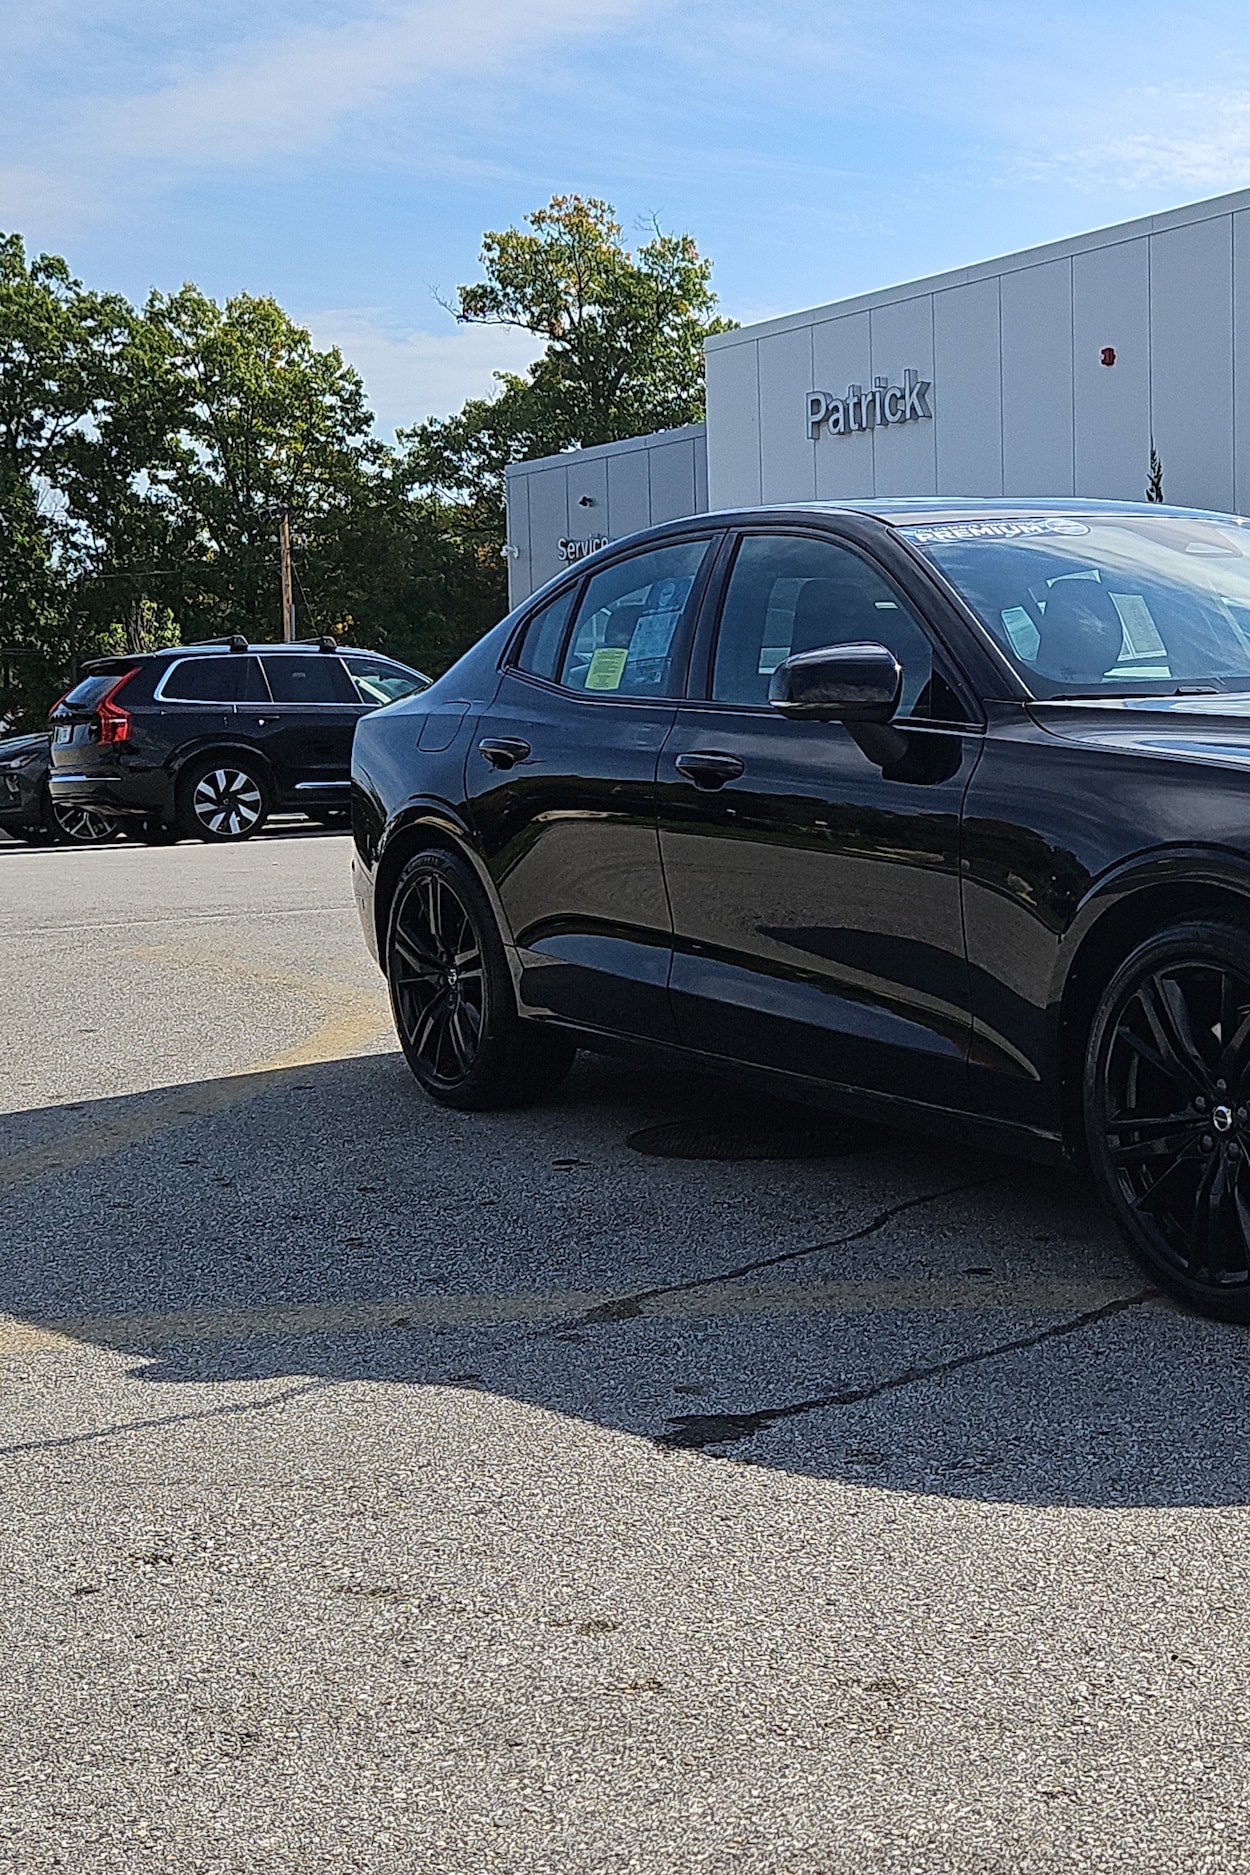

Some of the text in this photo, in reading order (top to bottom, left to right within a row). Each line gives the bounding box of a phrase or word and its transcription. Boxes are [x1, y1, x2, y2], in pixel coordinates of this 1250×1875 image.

[805, 368, 932, 440] Patrick
[914, 522, 1044, 542] PREMIUM
[557, 533, 609, 561] Service
